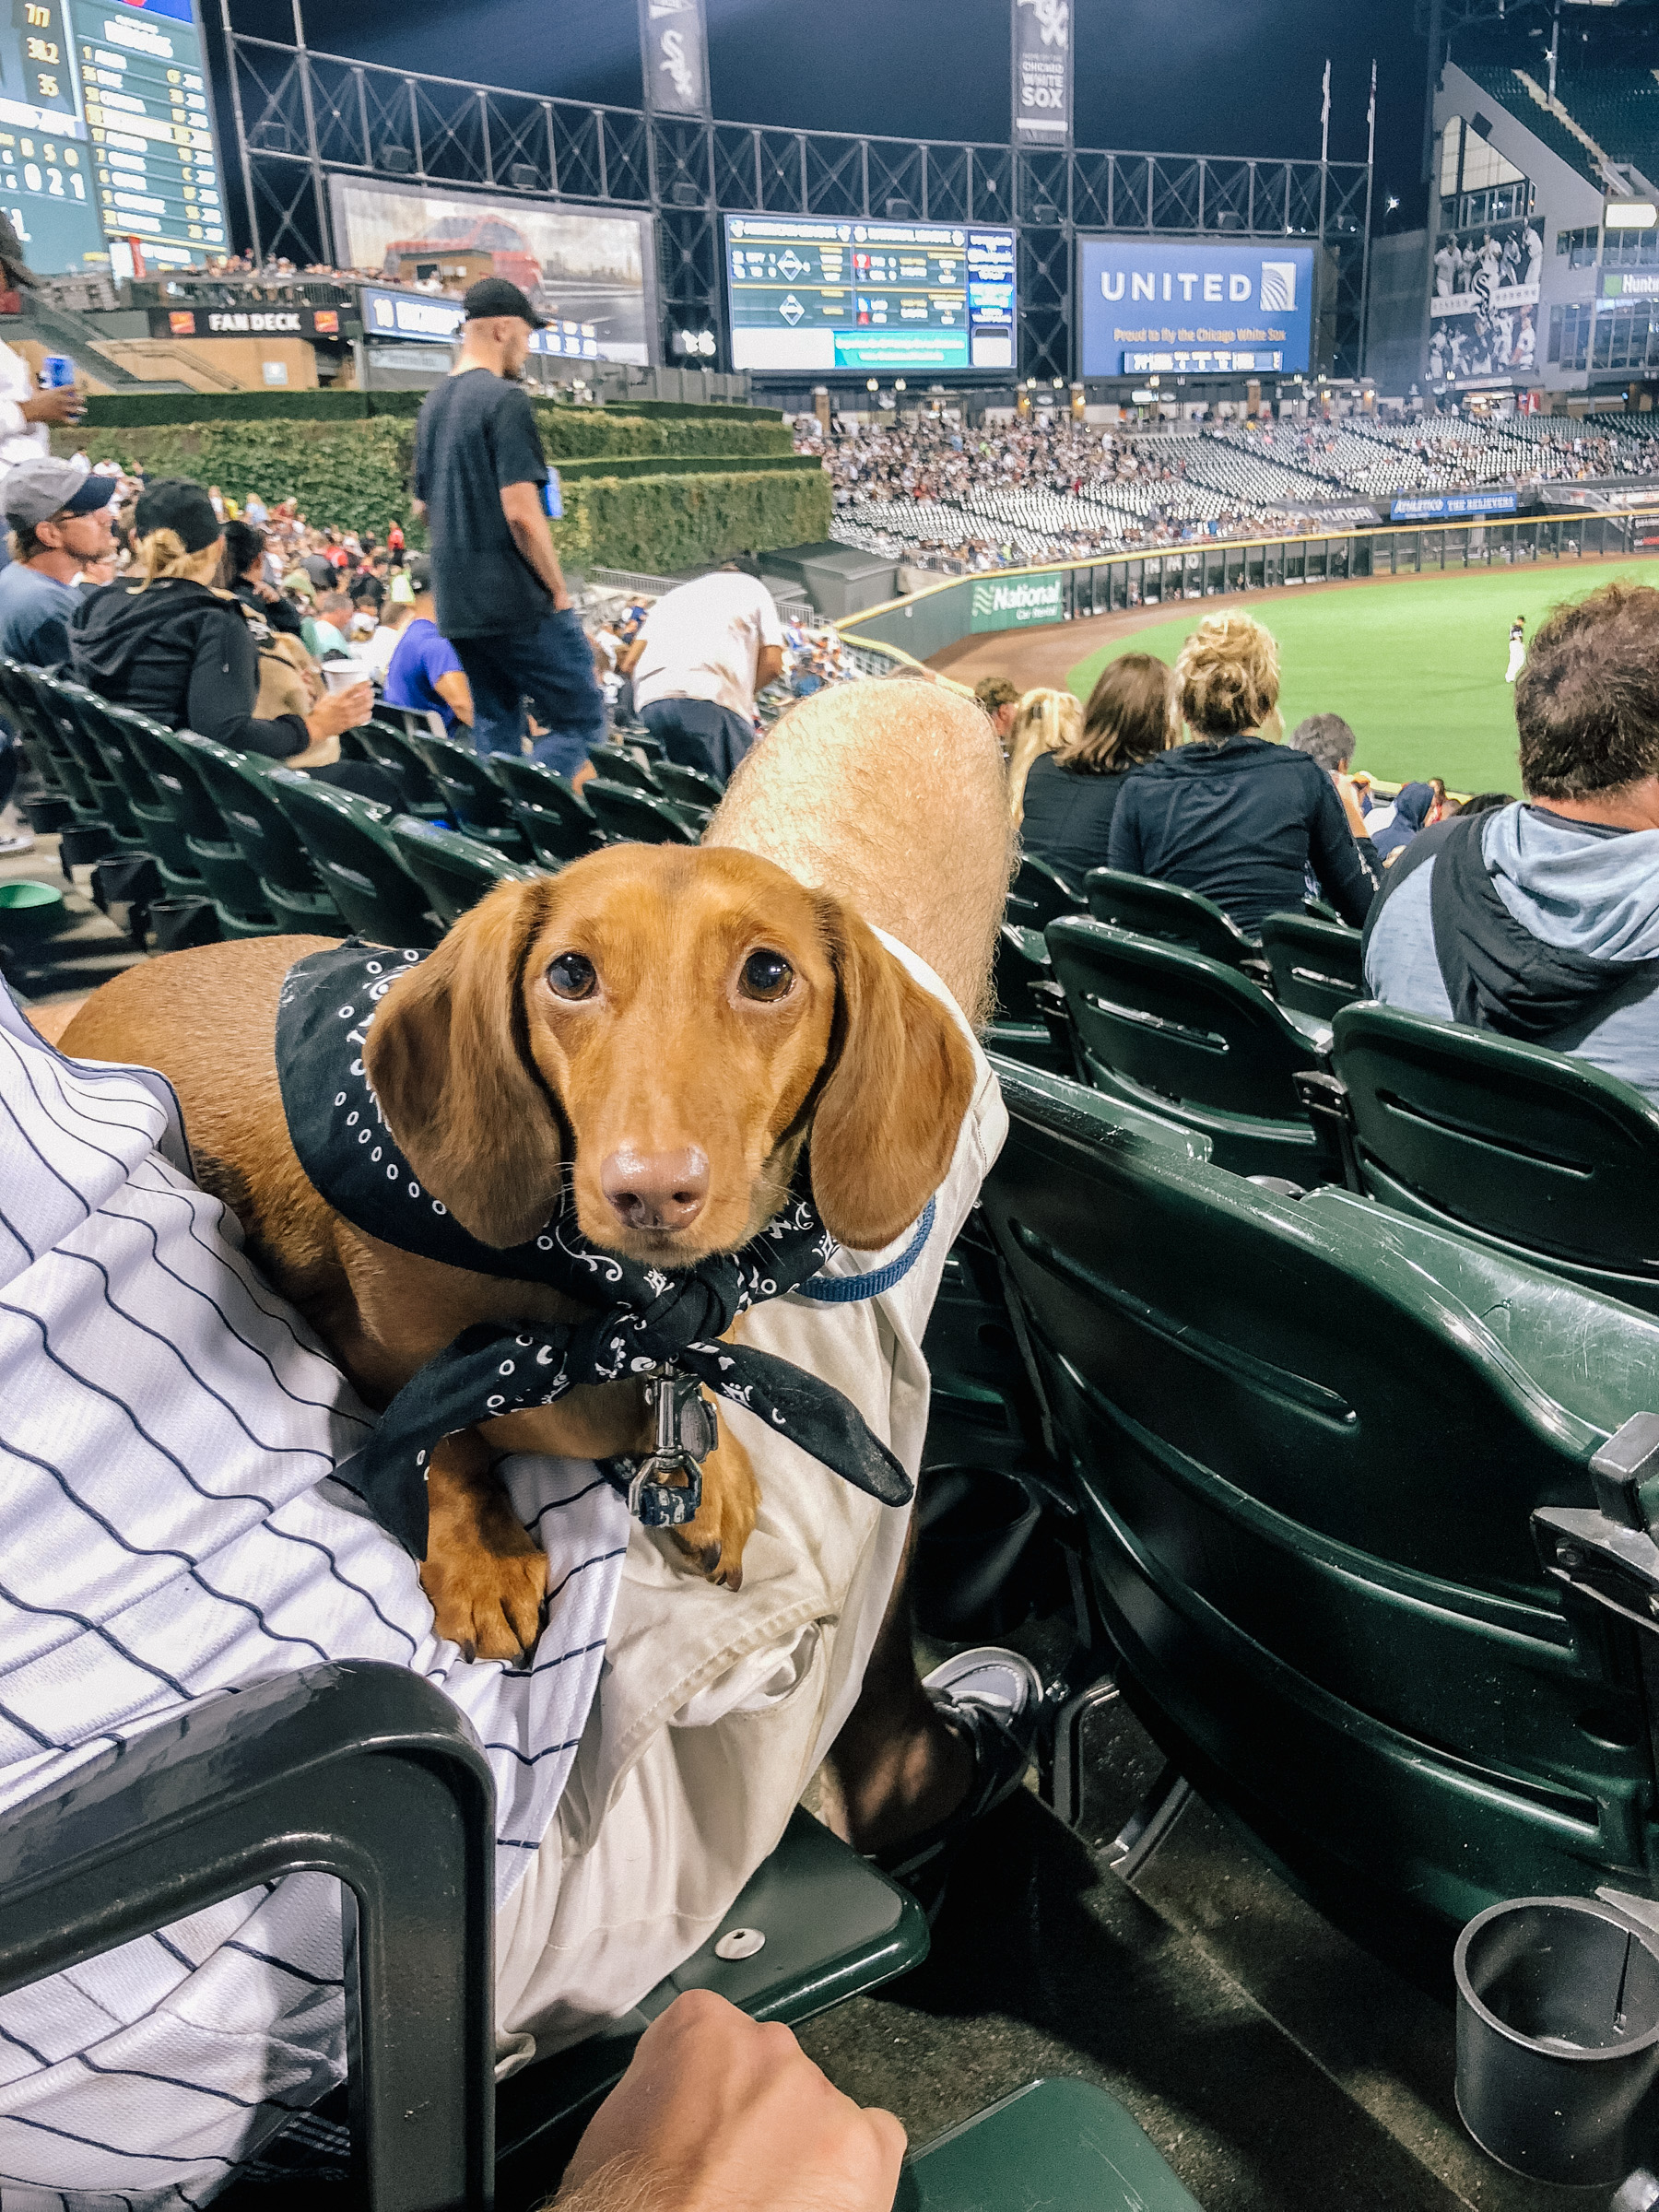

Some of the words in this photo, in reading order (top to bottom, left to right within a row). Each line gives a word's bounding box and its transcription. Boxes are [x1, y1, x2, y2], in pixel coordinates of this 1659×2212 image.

[1021, 72, 1064, 88] WHITE
[1021, 86, 1064, 109] SOX
[46, 167, 65, 197] 2
[69, 176, 87, 200] 1
[1100, 271, 1253, 302] UNITED
[208, 312, 249, 332] FAN
[249, 312, 302, 332] DECK
[1113, 327, 1147, 342] Proud
[1148, 328, 1160, 342] to
[1178, 327, 1195, 342] the
[1196, 327, 1235, 345] Chicago
[1236, 326, 1267, 342] White
[1267, 327, 1287, 343] Sox
[1447, 499, 1466, 512] THE
[993, 579, 1061, 611] National
[1016, 608, 1031, 621] Car
